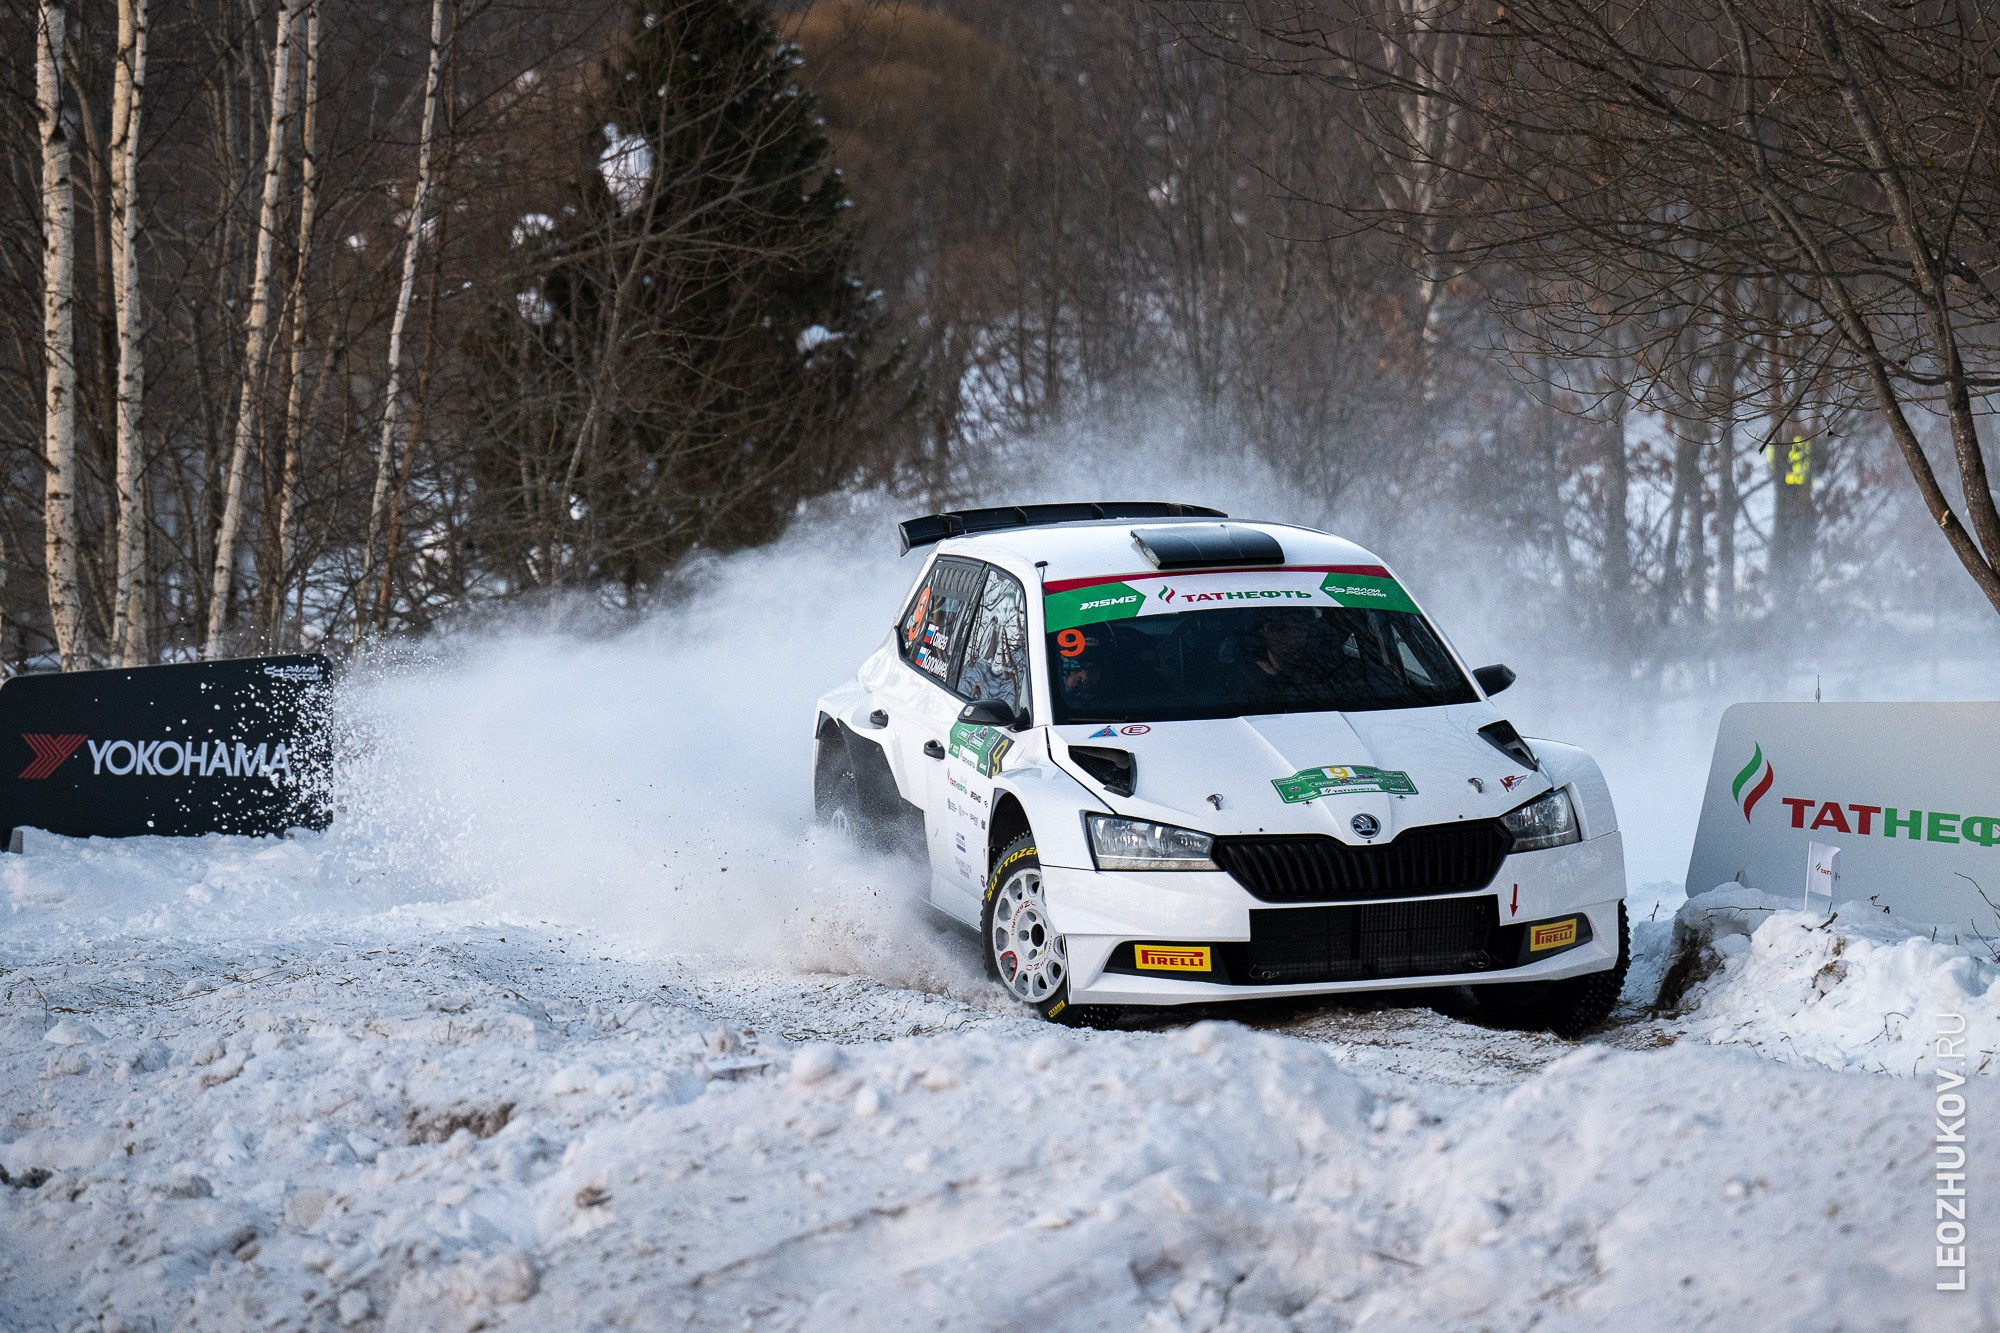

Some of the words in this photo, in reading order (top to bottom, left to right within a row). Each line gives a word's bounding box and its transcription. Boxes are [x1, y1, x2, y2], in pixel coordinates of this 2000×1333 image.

[1181, 590, 1312, 602] ТАТНЕФТЬ
[908, 586, 931, 641] 9
[1057, 628, 1085, 657] 9
[87, 739, 292, 777] YOKOHAMA
[1328, 765, 1349, 779] 9
[1534, 923, 1573, 945] PIRELLI
[1141, 950, 1204, 967] PIRELLI
